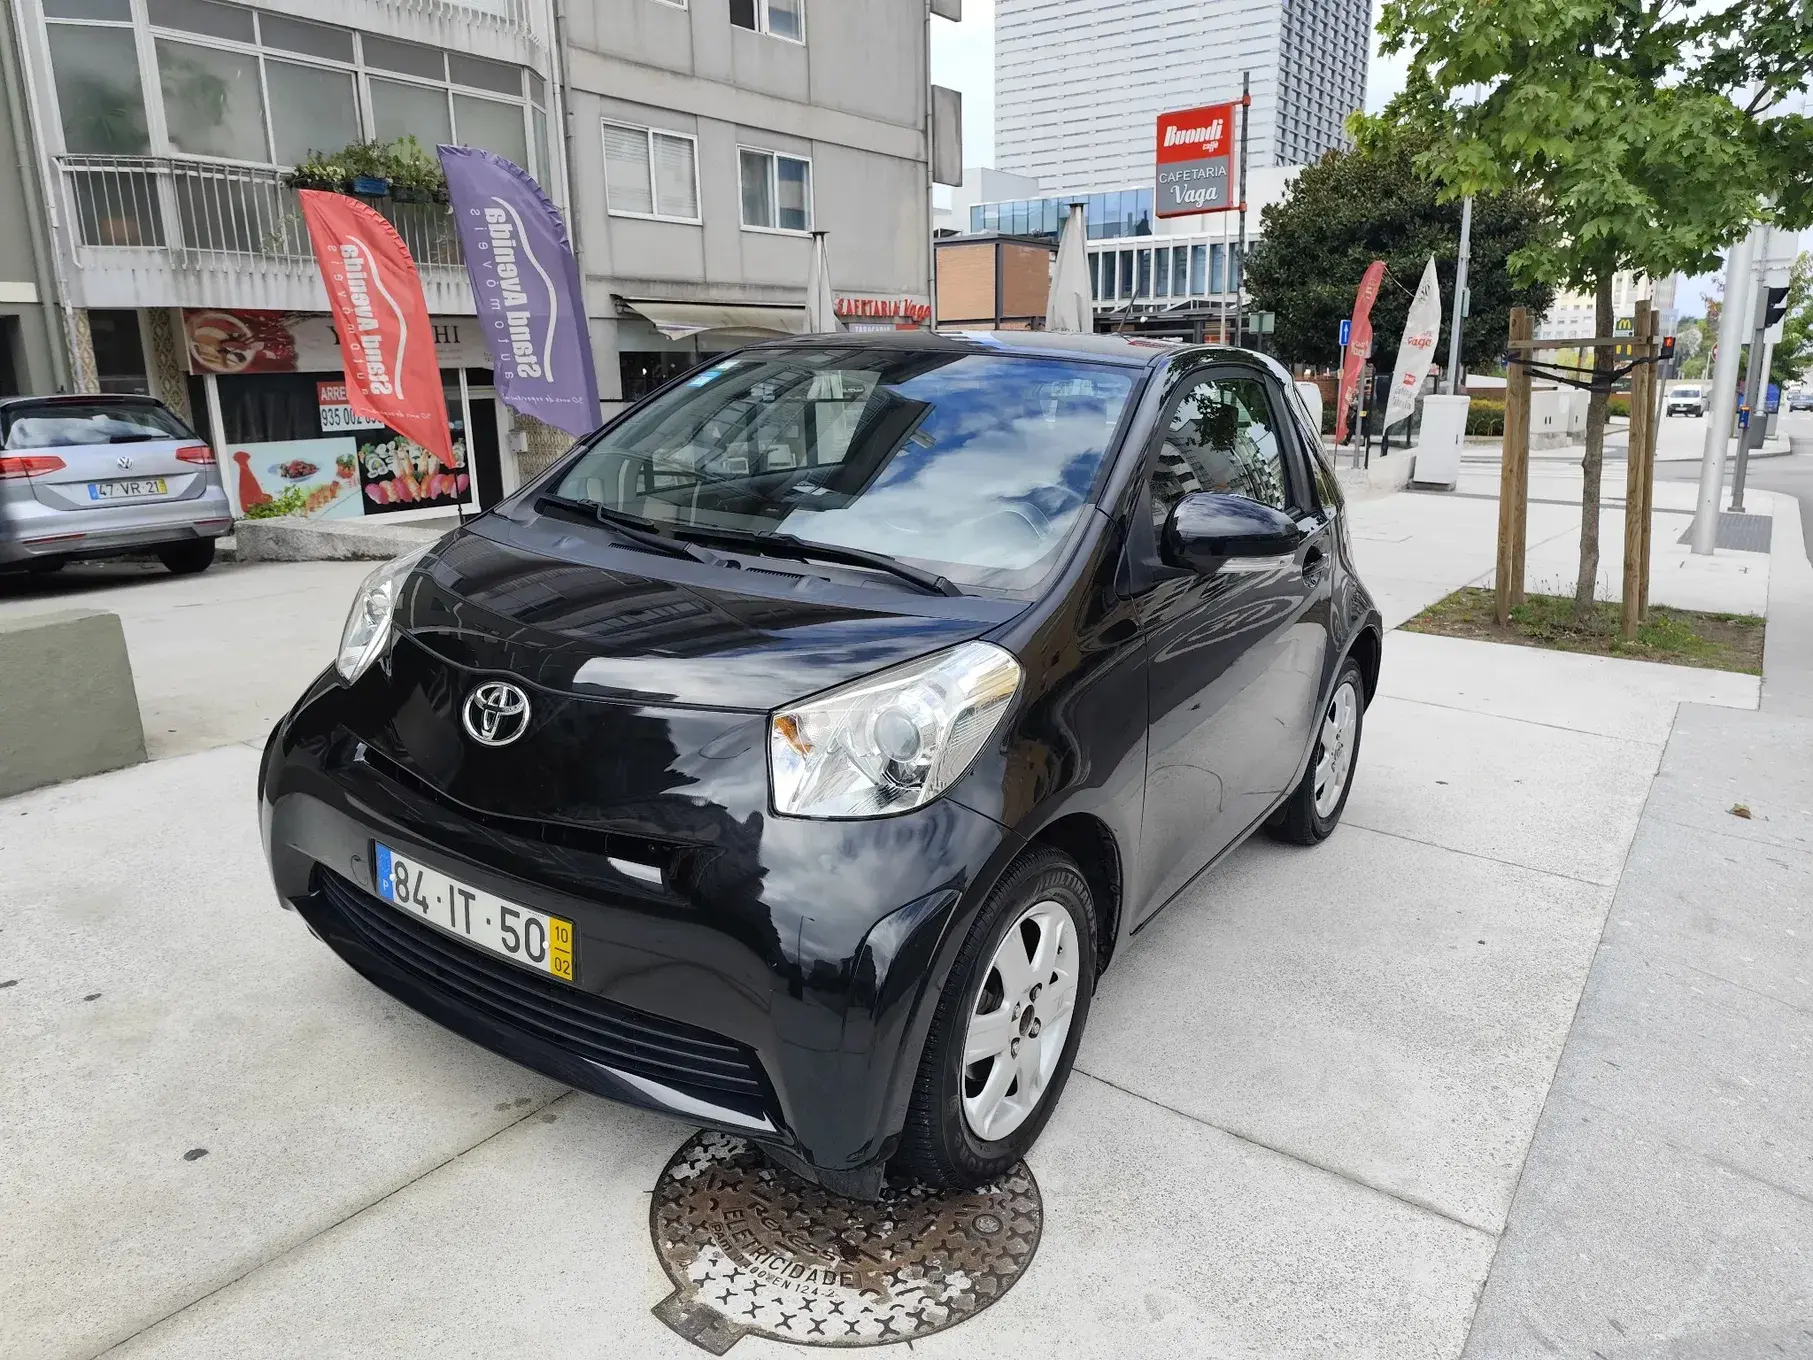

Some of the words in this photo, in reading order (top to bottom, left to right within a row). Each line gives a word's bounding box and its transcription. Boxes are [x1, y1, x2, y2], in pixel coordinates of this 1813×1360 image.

[1163, 118, 1224, 147] Buondi
[1159, 165, 1227, 183] CAFETARIA
[1170, 184, 1219, 208] Vaga
[837, 298, 900, 317] CAFETARIA
[903, 298, 931, 322] Vaga
[321, 408, 341, 427] 935
[555, 925, 569, 944] 10
[554, 956, 571, 976] 02
[723, 1209, 853, 1287] ELETRICIDADE
[772, 1276, 791, 1290] EN
